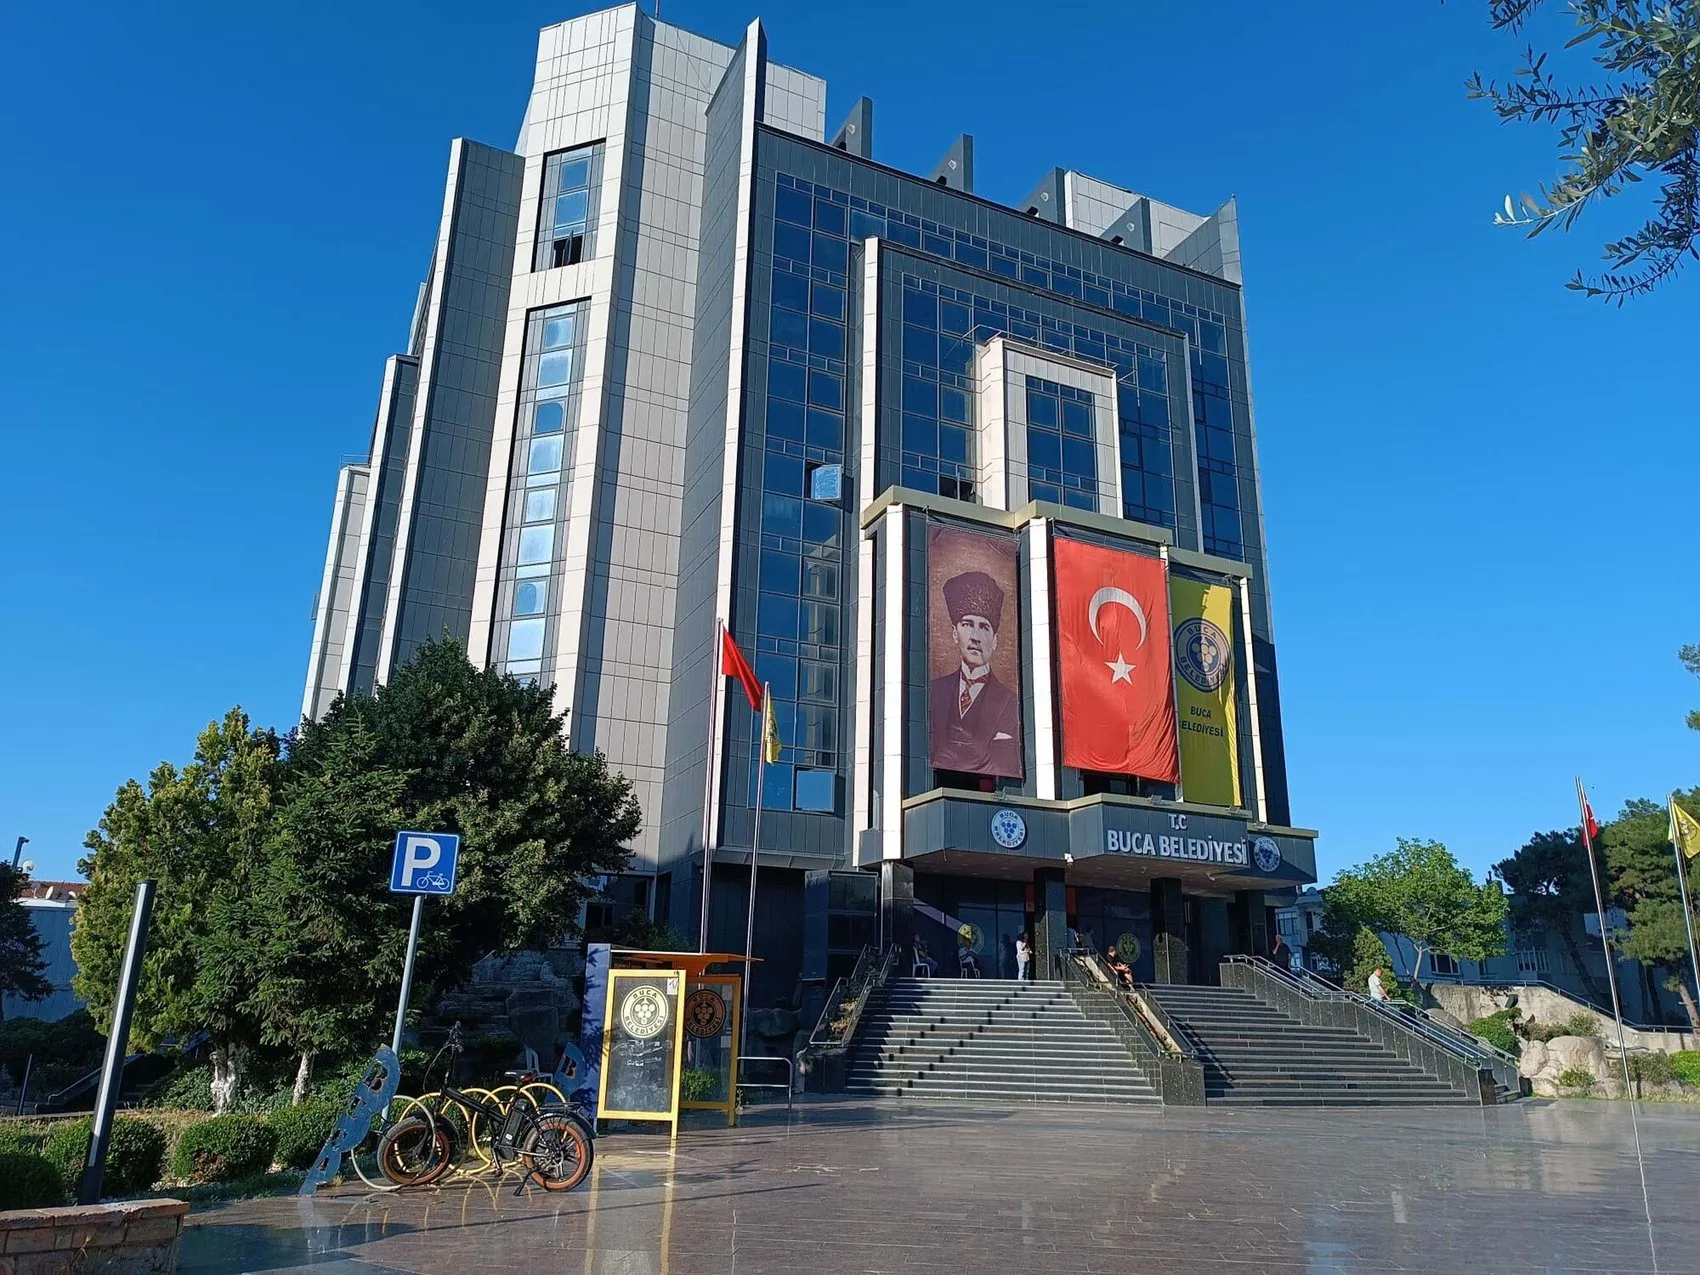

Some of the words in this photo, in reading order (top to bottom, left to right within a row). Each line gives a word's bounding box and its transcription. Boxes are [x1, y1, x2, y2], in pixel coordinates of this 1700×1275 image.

[1187, 625, 1216, 639] BUCA
[1190, 705, 1212, 718] BUCA
[1179, 720, 1224, 738] ELEDİYESİ
[1107, 829, 1156, 856] BUCA
[1158, 835, 1248, 865] BELEDİYESİ
[401, 836, 441, 887] P
[633, 989, 658, 999] BUCA
[624, 1014, 665, 1035] BELEDİYESİ
